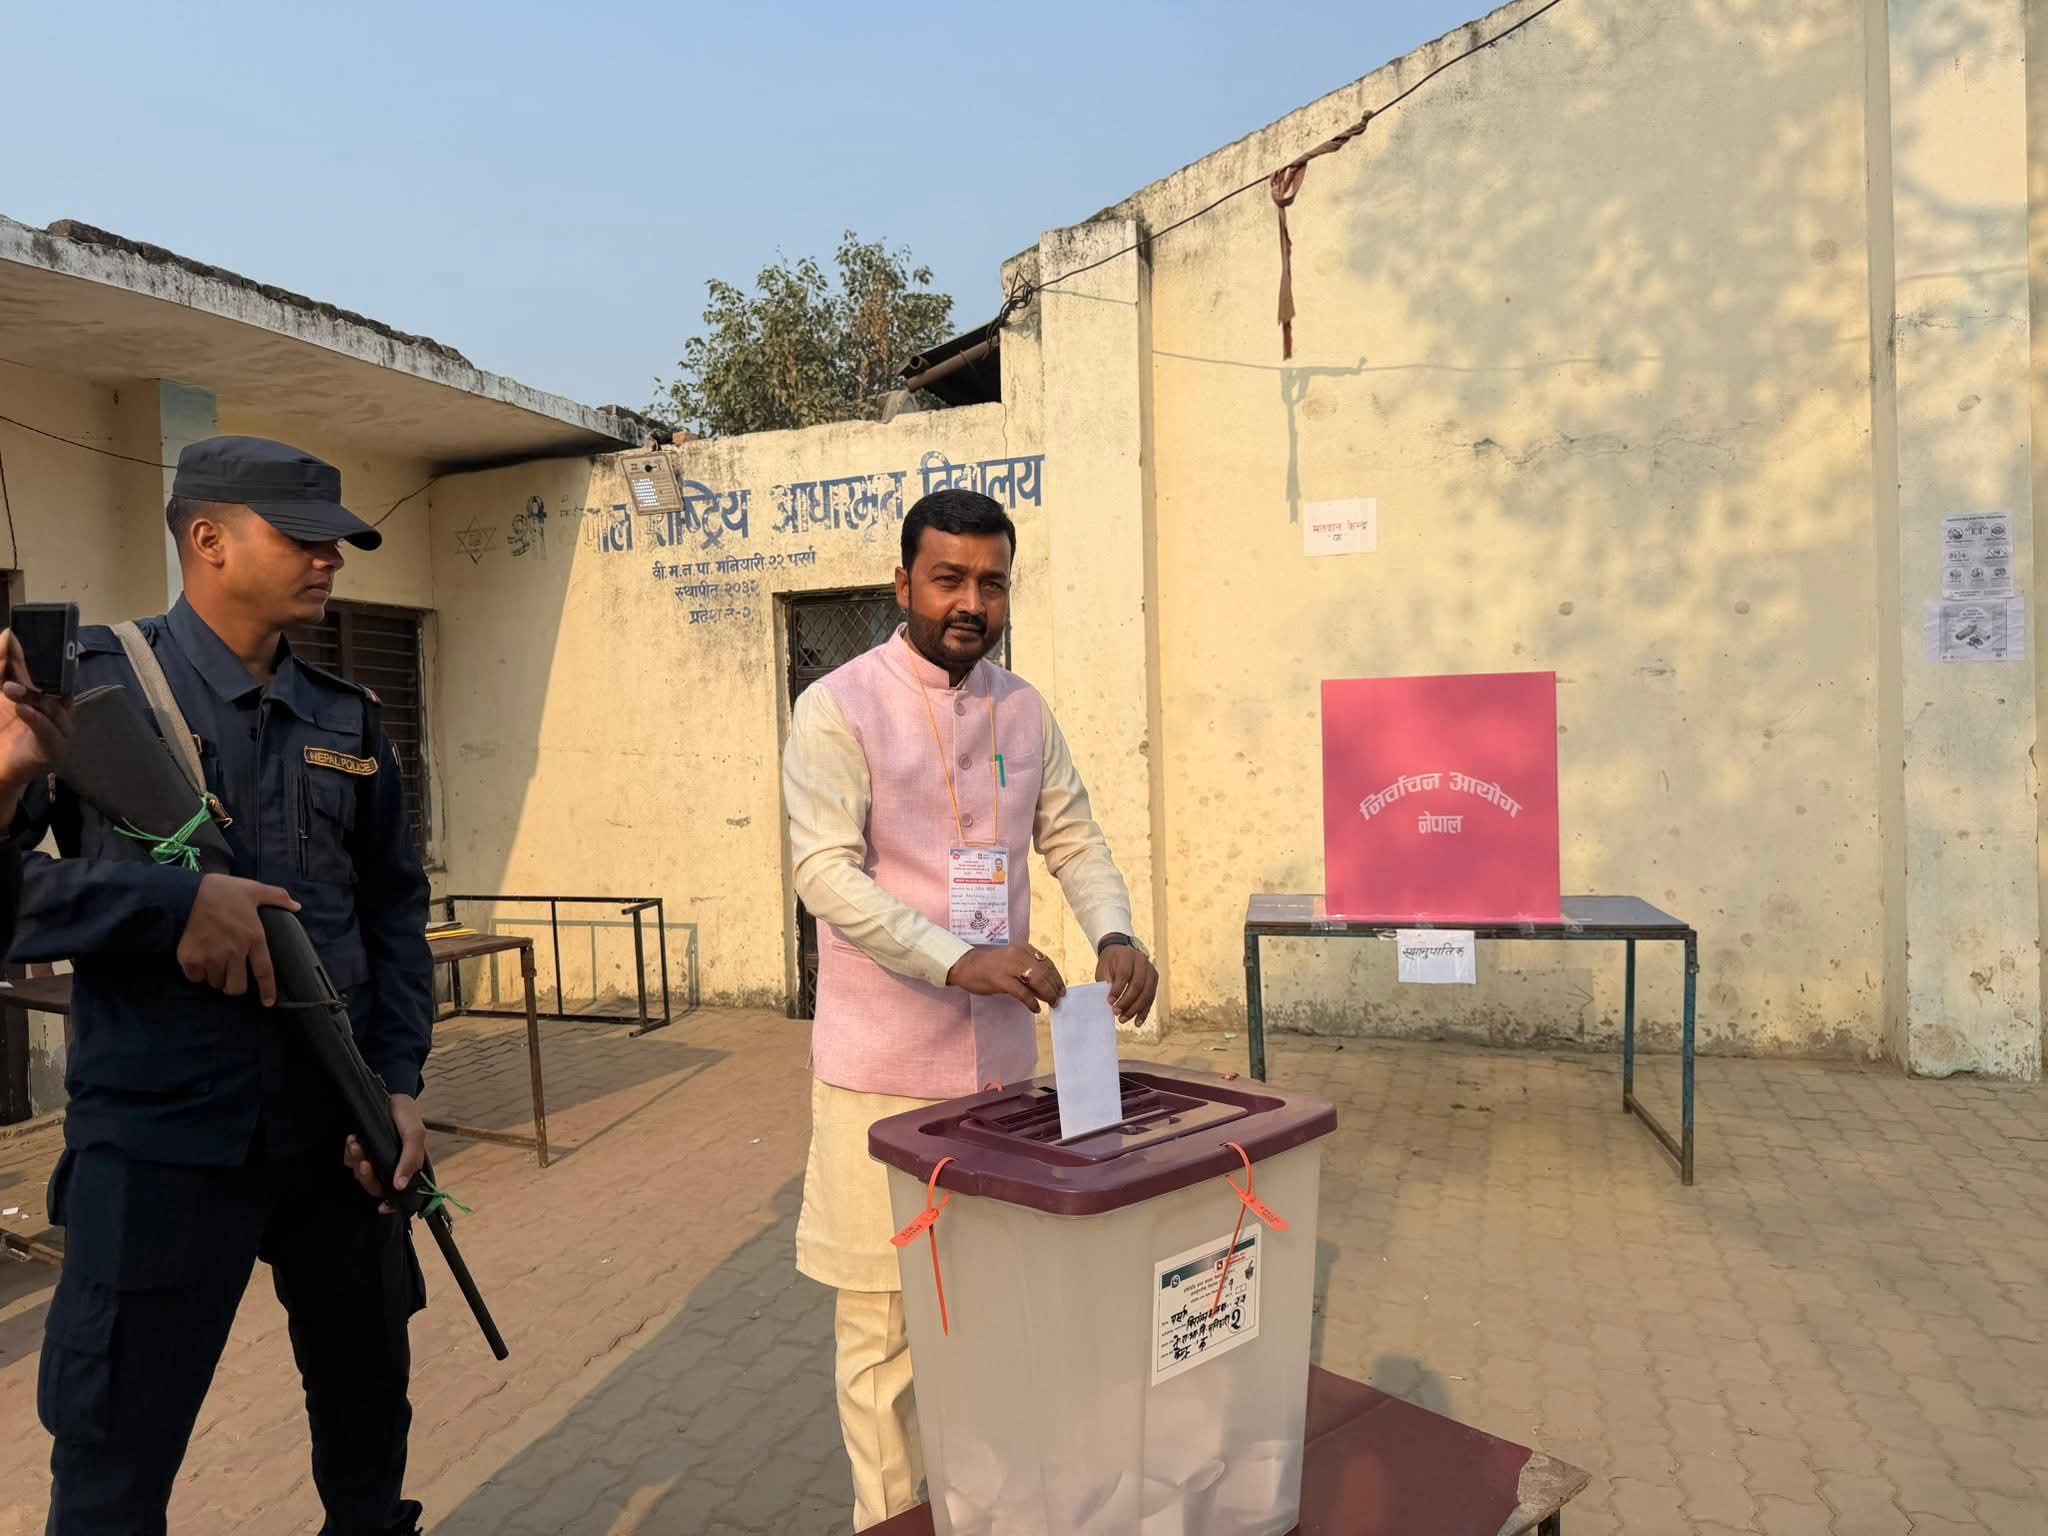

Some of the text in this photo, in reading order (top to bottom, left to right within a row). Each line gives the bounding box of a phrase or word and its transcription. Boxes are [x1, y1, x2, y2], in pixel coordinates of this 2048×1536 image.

[310, 751, 370, 772] NEPAL POLICE
[1359, 772, 1523, 821] निर्वाचन आयोग
[1418, 811, 1463, 834] नेपाल
